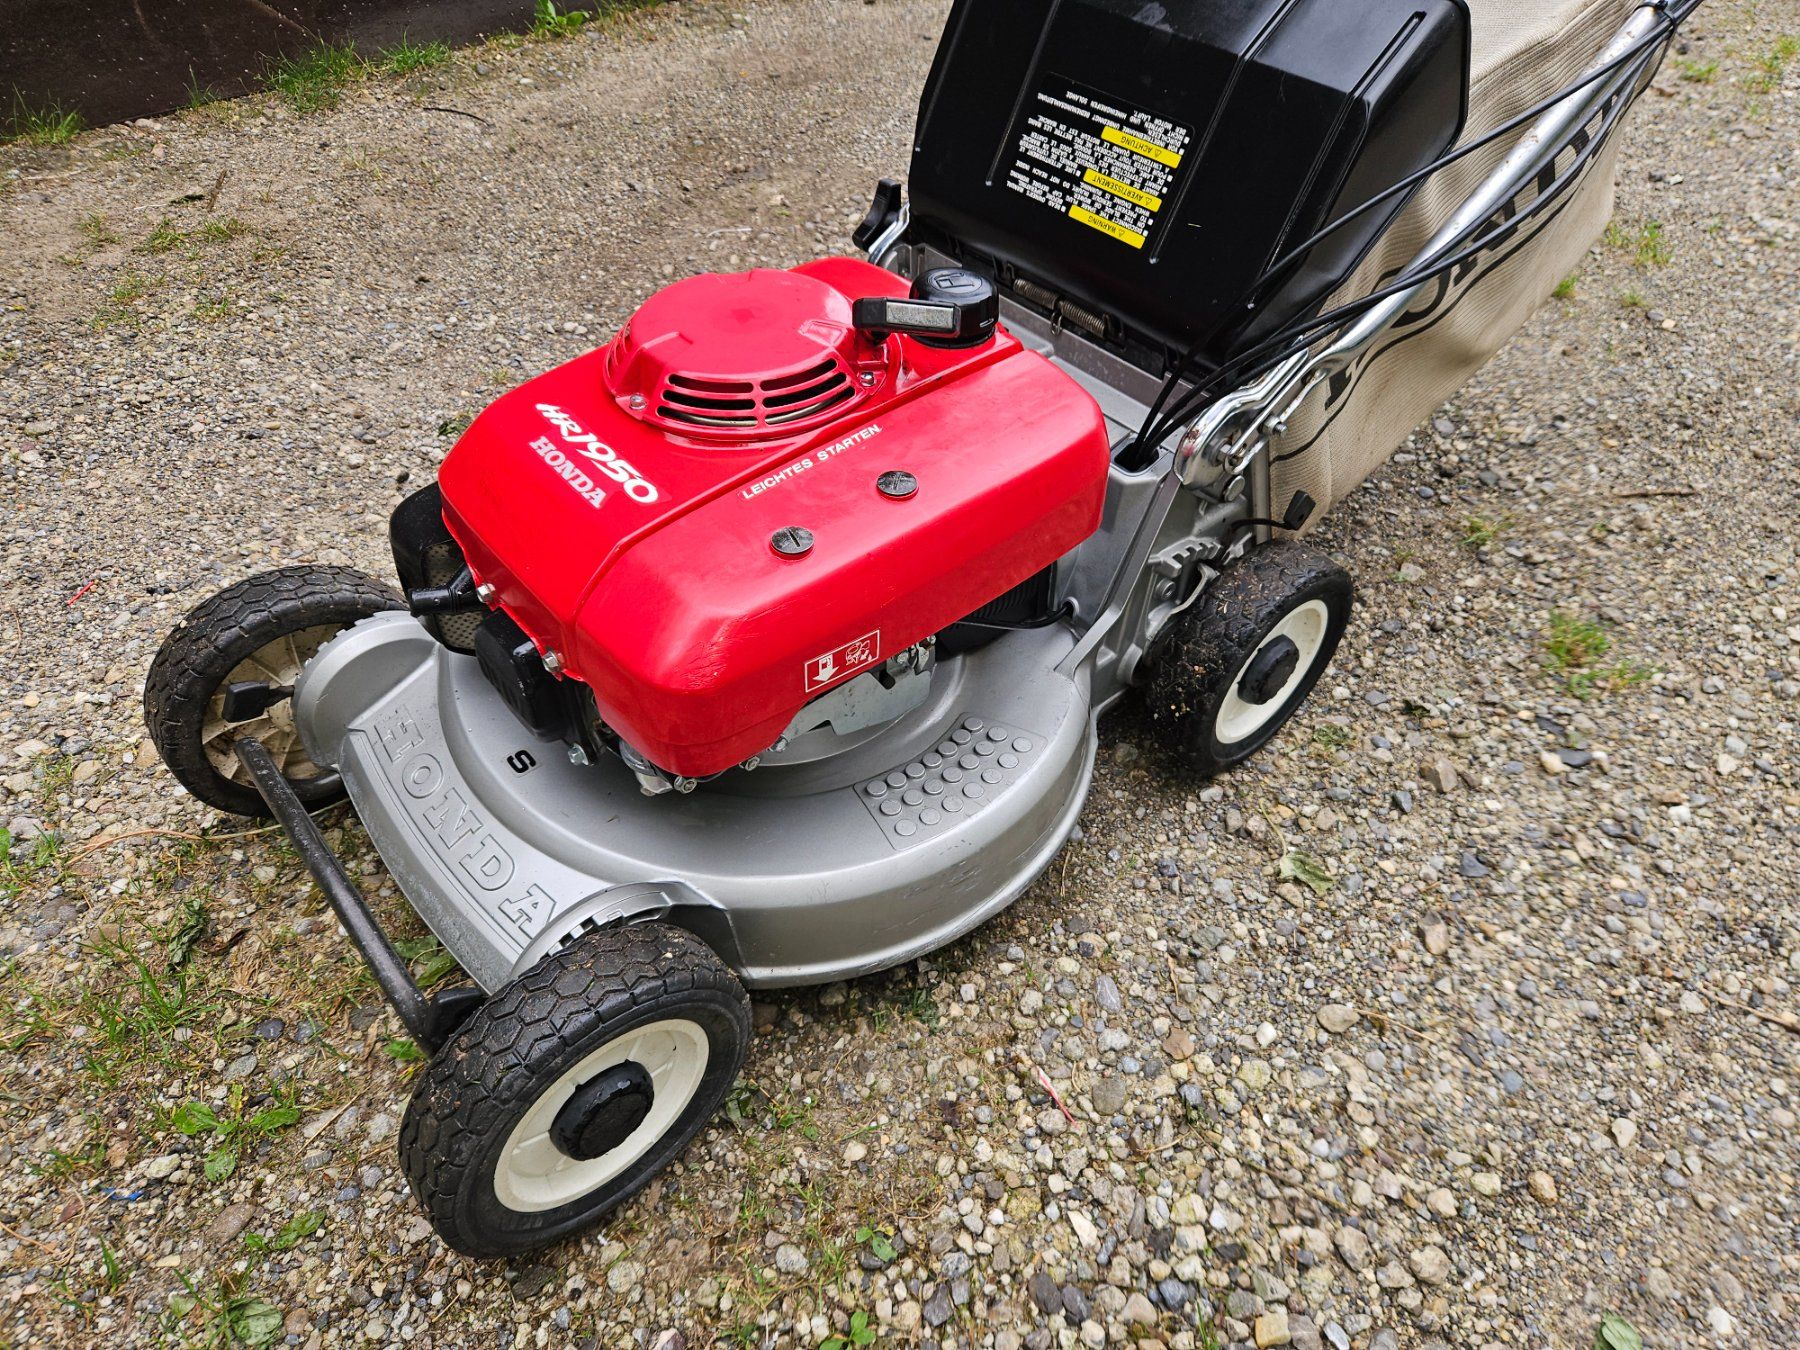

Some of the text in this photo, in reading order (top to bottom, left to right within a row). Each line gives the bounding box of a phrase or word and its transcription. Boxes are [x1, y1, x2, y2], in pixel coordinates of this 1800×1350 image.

[1129, 116, 1140, 124] UND
[1154, 118, 1171, 128] MOTOR
[1030, 132, 1047, 142] CARTER
[1054, 128, 1072, 139] METTRE
[1080, 133, 1099, 144] MOTEUR
[1059, 144, 1071, 152] SOUS
[1121, 136, 1151, 152] ACHTUNG
[1051, 147, 1067, 157] GAZON
[1093, 145, 1117, 158] ACCIDENT
[1112, 145, 1129, 156] QUAND
[1119, 155, 1131, 164] TOUT
[1032, 168, 1047, 178] REACH
[1111, 172, 1130, 183] METTRE
[1152, 169, 1166, 178] POUR
[1050, 175, 1059, 183] NOT
[1032, 180, 1049, 191] BEFORE
[1093, 175, 1142, 200] AVERTISSEMENT
[1143, 186, 1158, 195] AVANT
[1145, 180, 1160, 190] AVANT
[1046, 193, 1062, 203] BEFORE
[1052, 189, 1062, 197] CAP
[1048, 200, 1060, 209] READ
[1092, 194, 1111, 206] SERIOUS
[1113, 197, 1131, 208] ENGINE
[1104, 206, 1120, 216] BLADE
[1115, 205, 1137, 217] PREVENT
[1135, 206, 1149, 216] WHEN
[1088, 216, 1116, 232] WARNING
[1112, 217, 1142, 233] DISCONNECT
[742, 425, 880, 499] LEICHTES STARTEN
[528, 436, 606, 509] HONDA
[506, 749, 536, 774] S
[374, 706, 557, 940] HONDA
